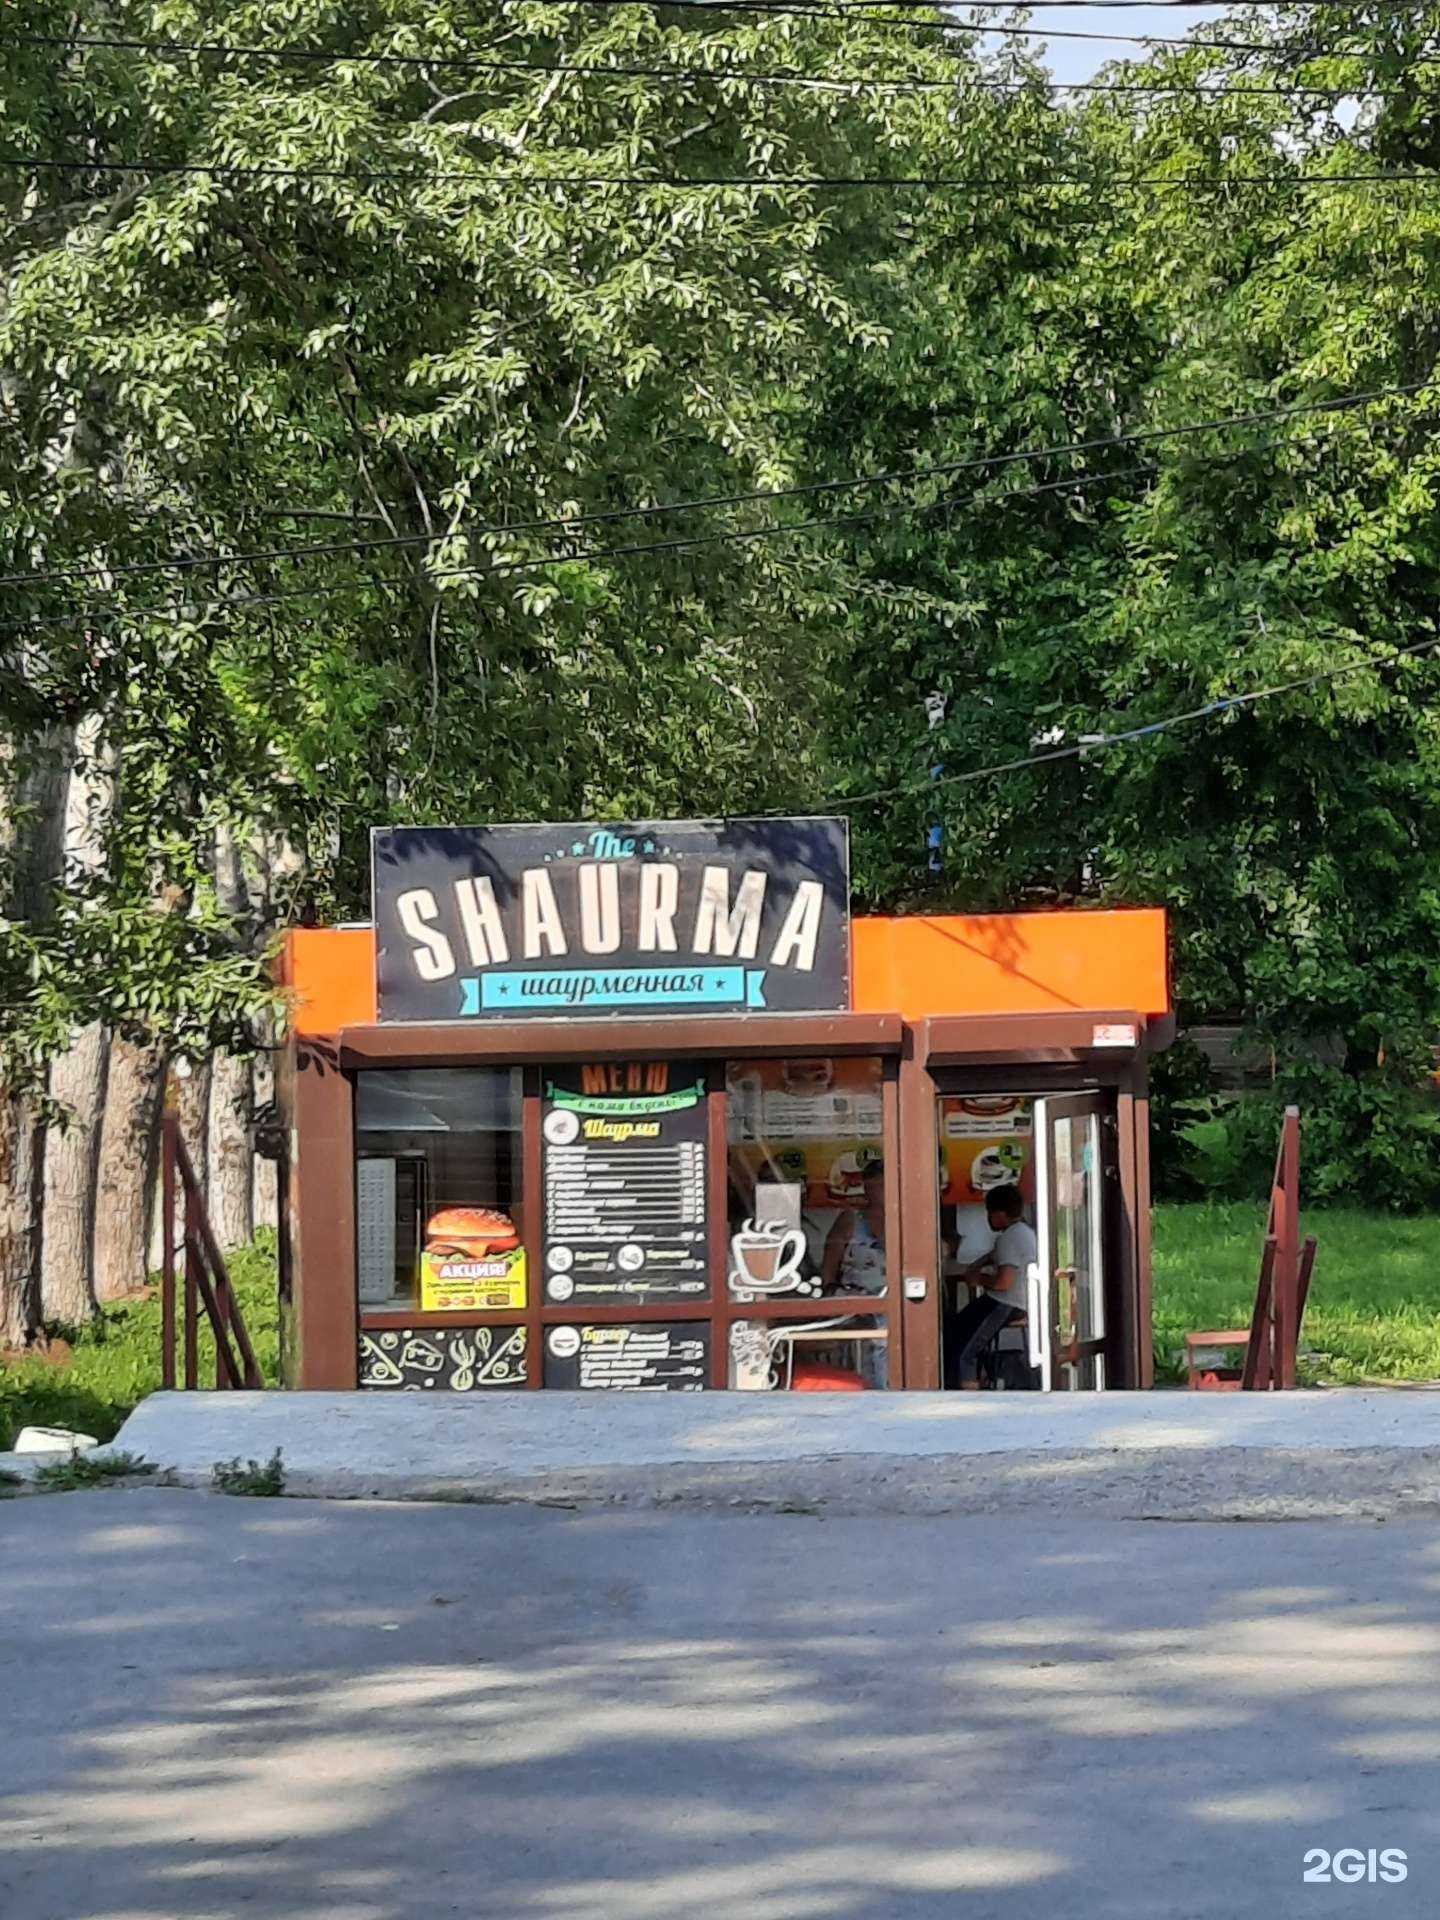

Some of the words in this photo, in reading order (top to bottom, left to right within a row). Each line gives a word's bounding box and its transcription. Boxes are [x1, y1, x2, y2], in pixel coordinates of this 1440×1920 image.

[588, 830, 636, 859] The
[396, 862, 825, 982] SHAURMA
[521, 974, 704, 1003] шаурменная
[582, 1118, 661, 1143] Шаурма
